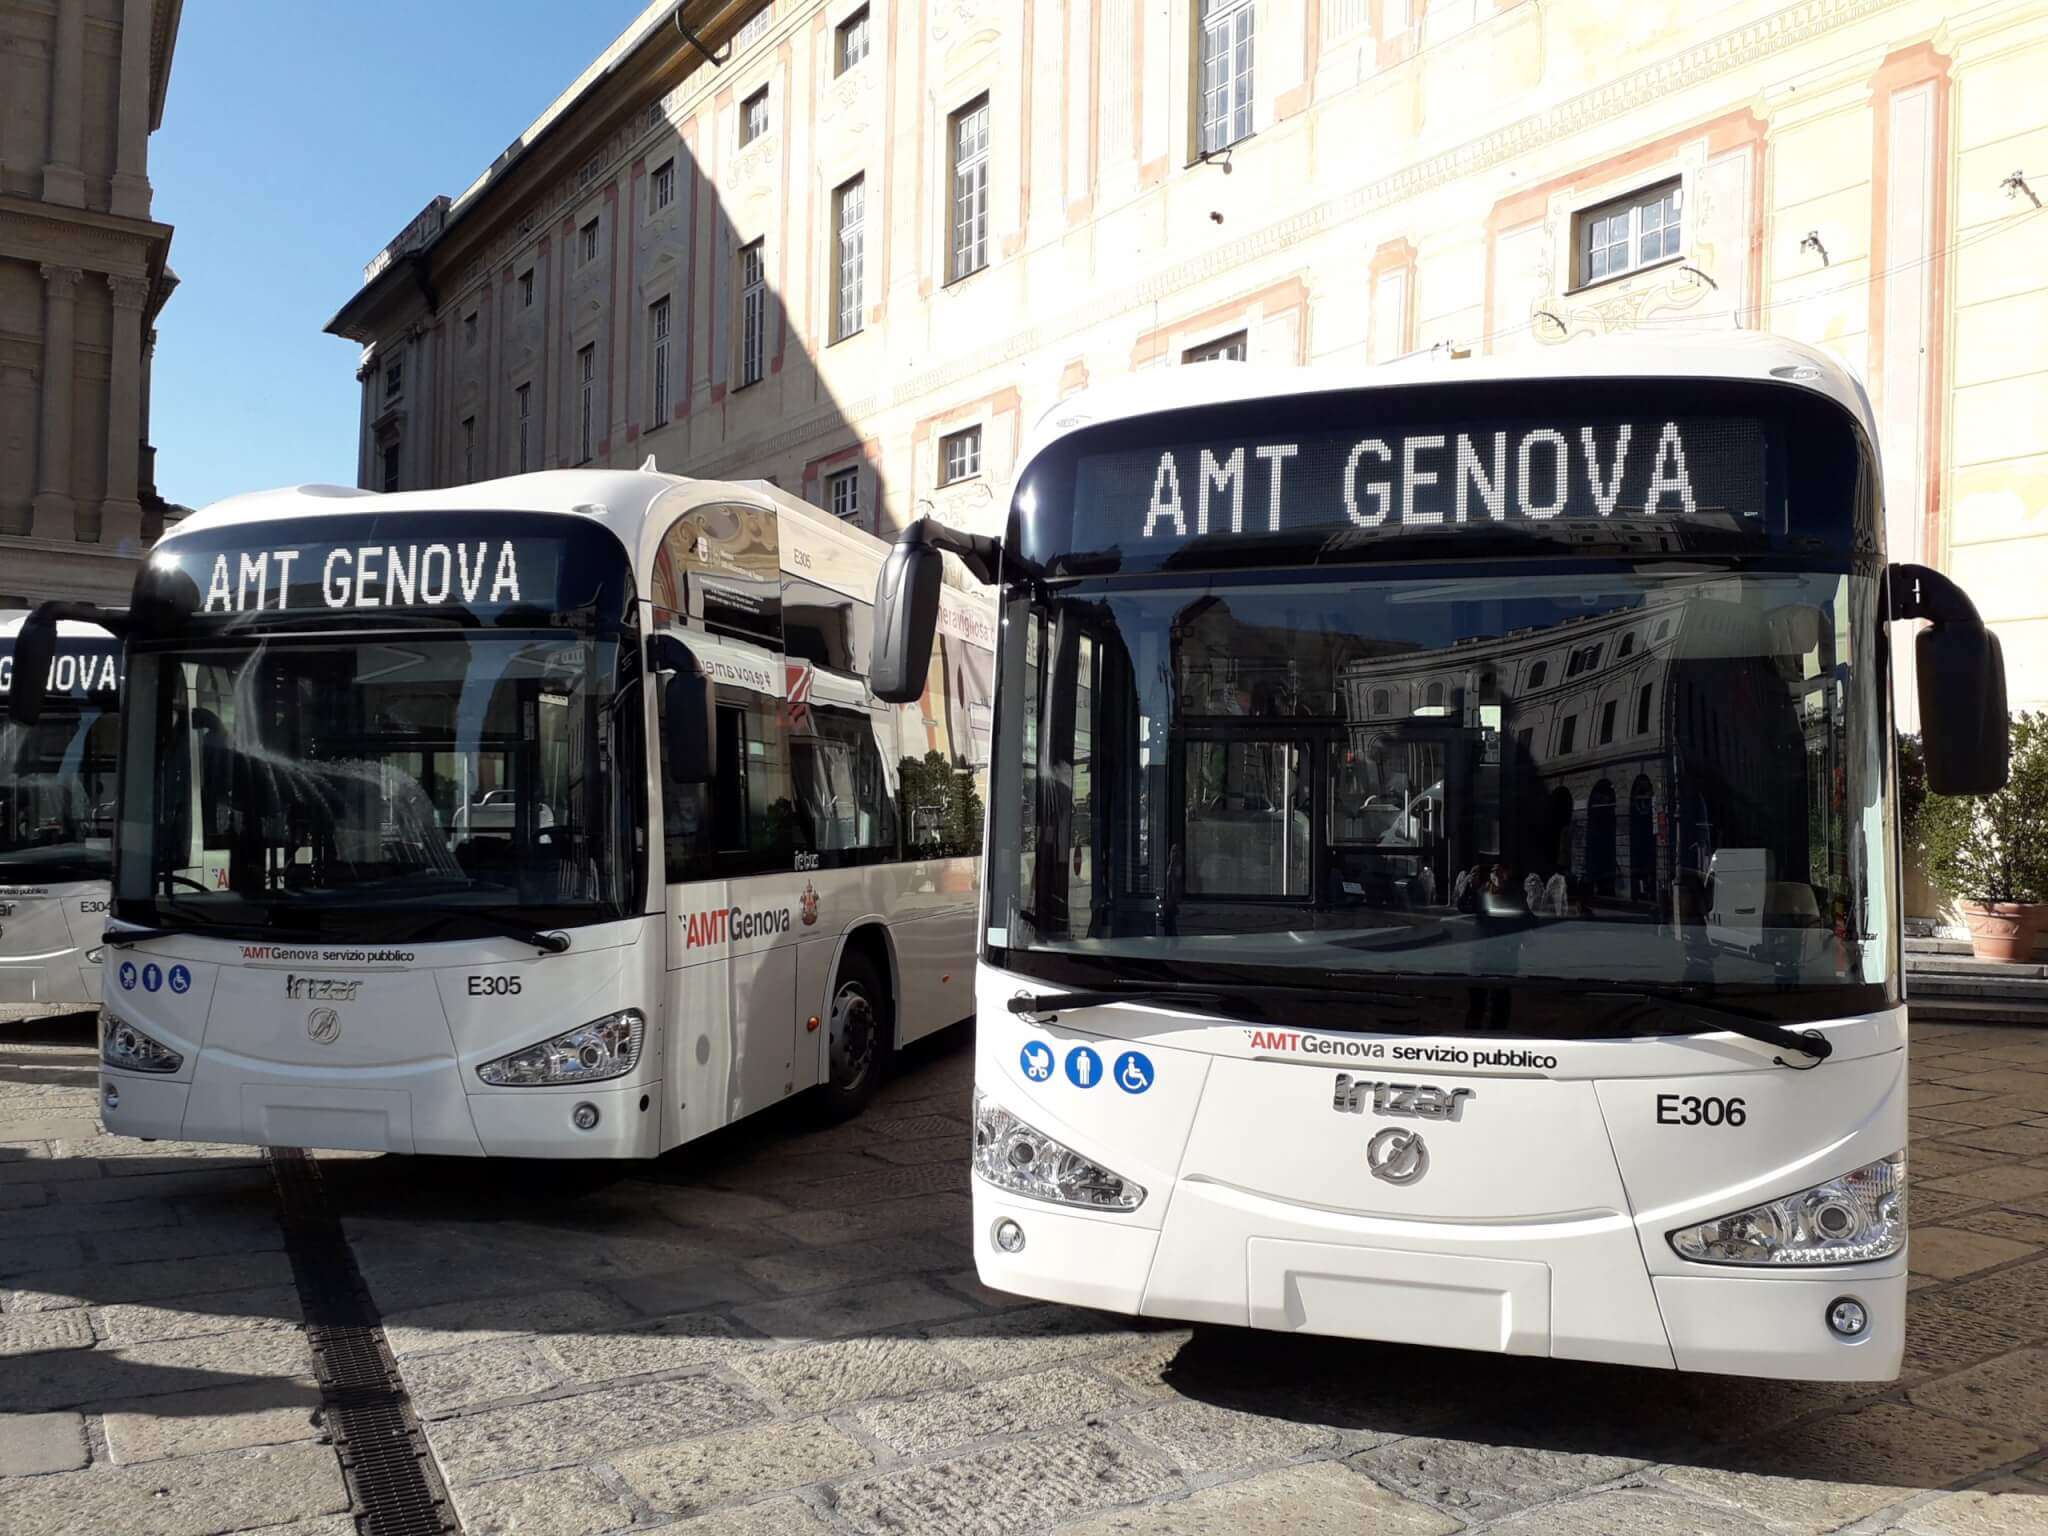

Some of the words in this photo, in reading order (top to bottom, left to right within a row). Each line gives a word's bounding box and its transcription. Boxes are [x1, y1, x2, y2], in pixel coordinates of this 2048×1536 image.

[1143, 443, 1299, 537] AMT
[1343, 421, 1697, 528] GENOVA
[794, 548, 811, 569] E305
[203, 550, 299, 613] AMT
[322, 540, 520, 608] GENOVA
[323, 951, 365, 961] servizio
[367, 950, 415, 963] pubblico
[468, 975, 522, 996] E305
[1392, 1045, 1469, 1064] servizio
[1473, 1049, 1558, 1070] pubblico
[1656, 1094, 1746, 1127] E306
